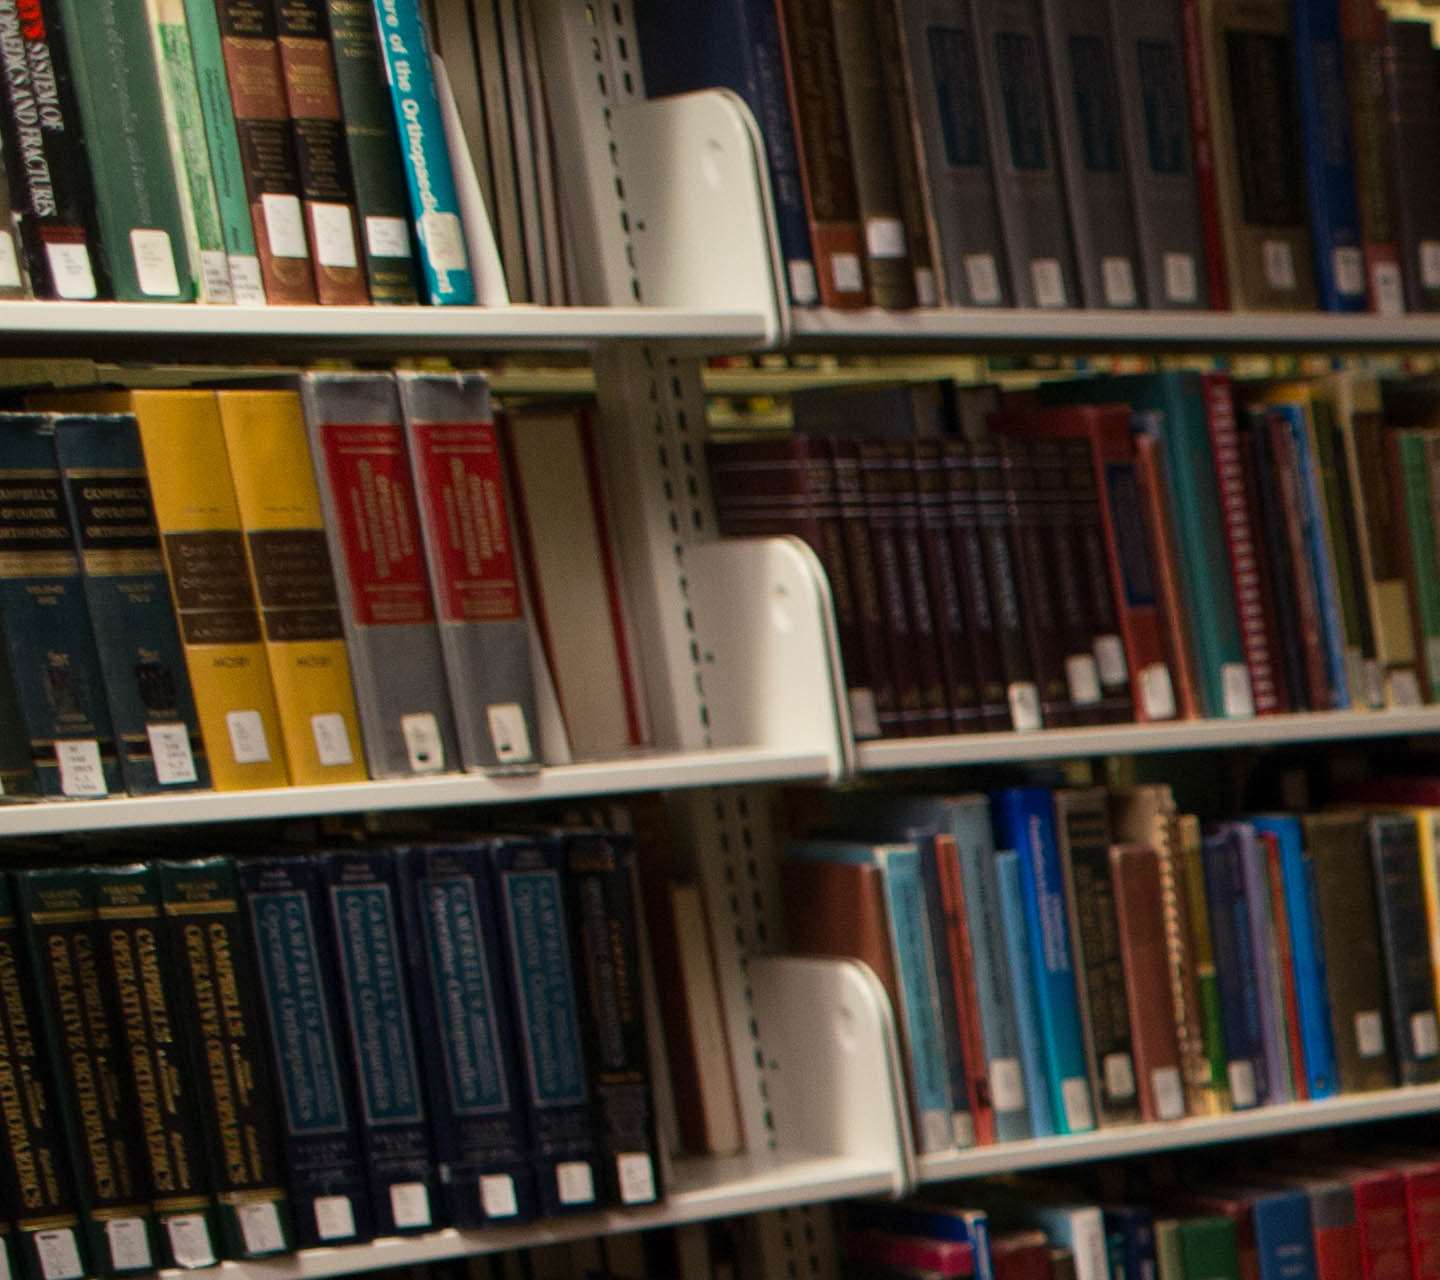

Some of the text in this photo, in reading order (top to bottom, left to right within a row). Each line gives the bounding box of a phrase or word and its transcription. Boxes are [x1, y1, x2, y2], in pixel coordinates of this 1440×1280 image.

[388, 31, 407, 55] of
[27, 39, 58, 103] SYSTEM
[394, 59, 414, 93] the
[10, 86, 38, 127] AND
[40, 104, 64, 133] OF
[18, 124, 57, 219] FRACTURES
